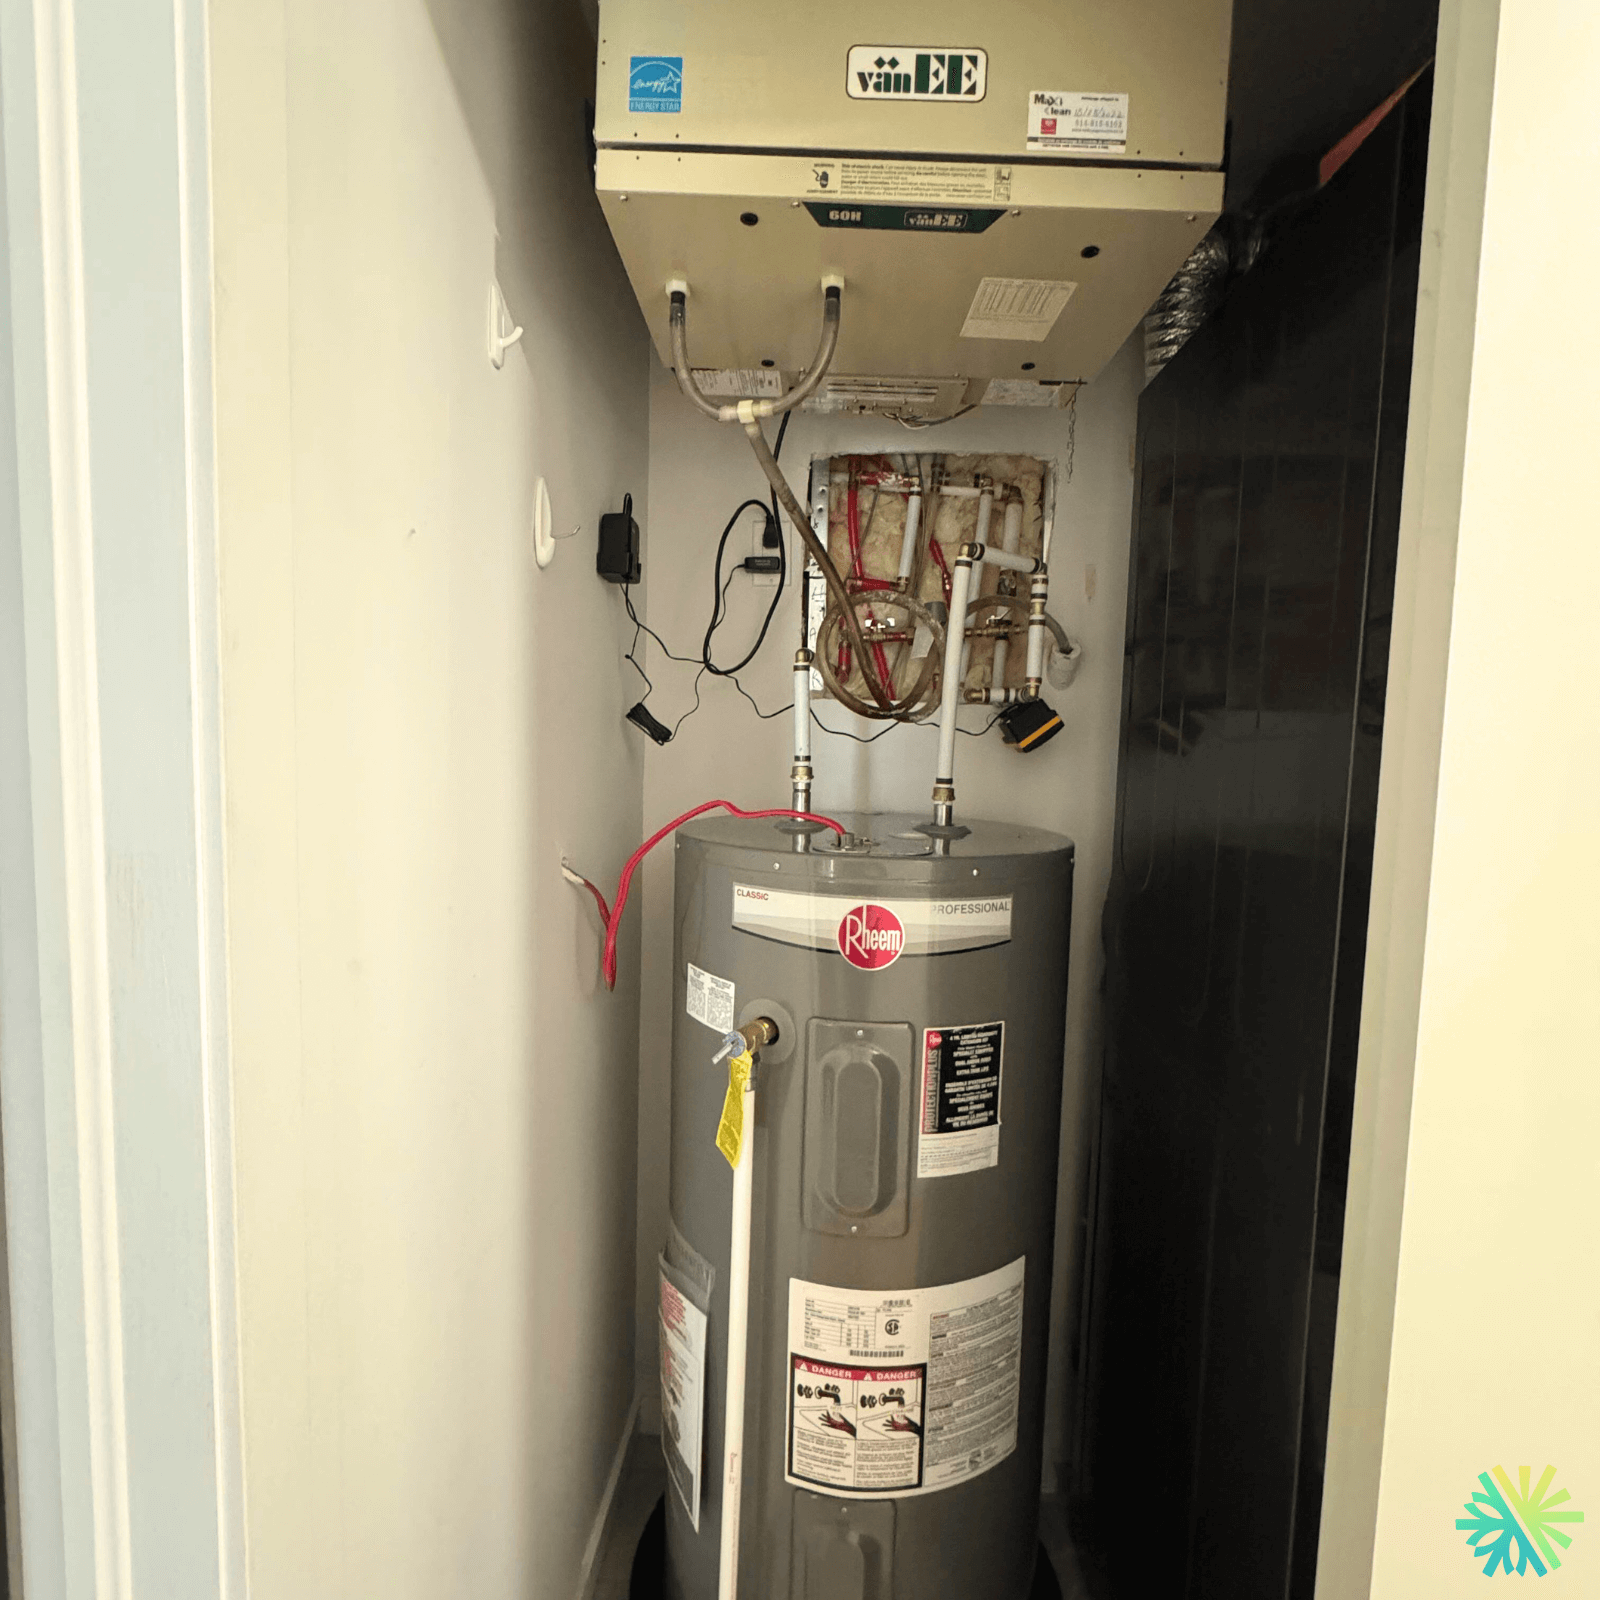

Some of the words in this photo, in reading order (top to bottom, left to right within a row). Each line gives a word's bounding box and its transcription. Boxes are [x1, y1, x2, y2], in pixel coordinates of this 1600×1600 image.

[630, 102, 659, 111] ENERGY
[660, 102, 680, 111] STAR
[828, 210, 862, 222] 60H
[736, 888, 769, 901] CLASSIC
[931, 901, 1010, 915] PROFESSIONAL
[845, 904, 902, 959] Rheem
[811, 1365, 852, 1379] DANGER
[876, 1371, 917, 1381] DANGER
